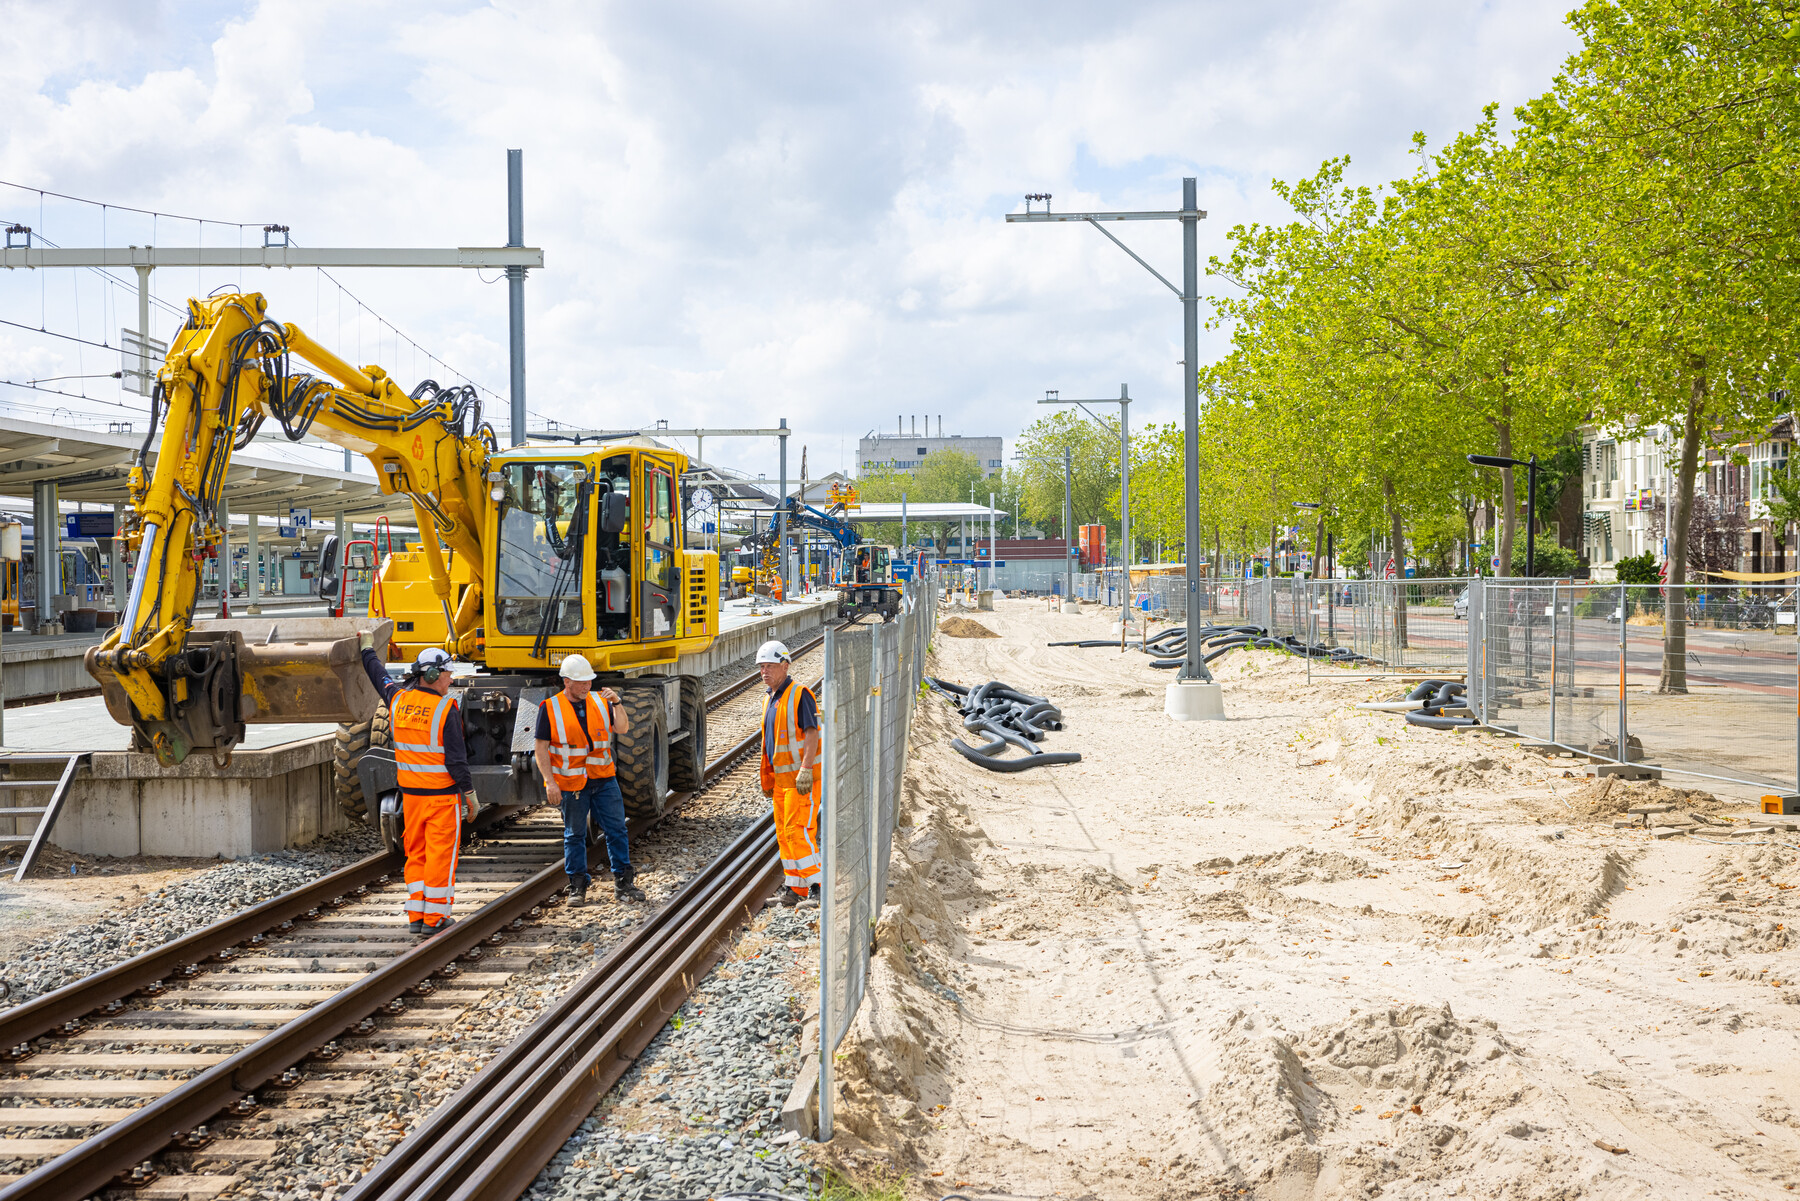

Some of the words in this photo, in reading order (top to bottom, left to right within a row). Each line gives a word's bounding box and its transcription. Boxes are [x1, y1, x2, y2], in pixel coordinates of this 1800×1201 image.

[294, 516, 307, 526] 14
[468, 679, 475, 687] H
[525, 679, 532, 687] V
[397, 704, 431, 716] HEGE
